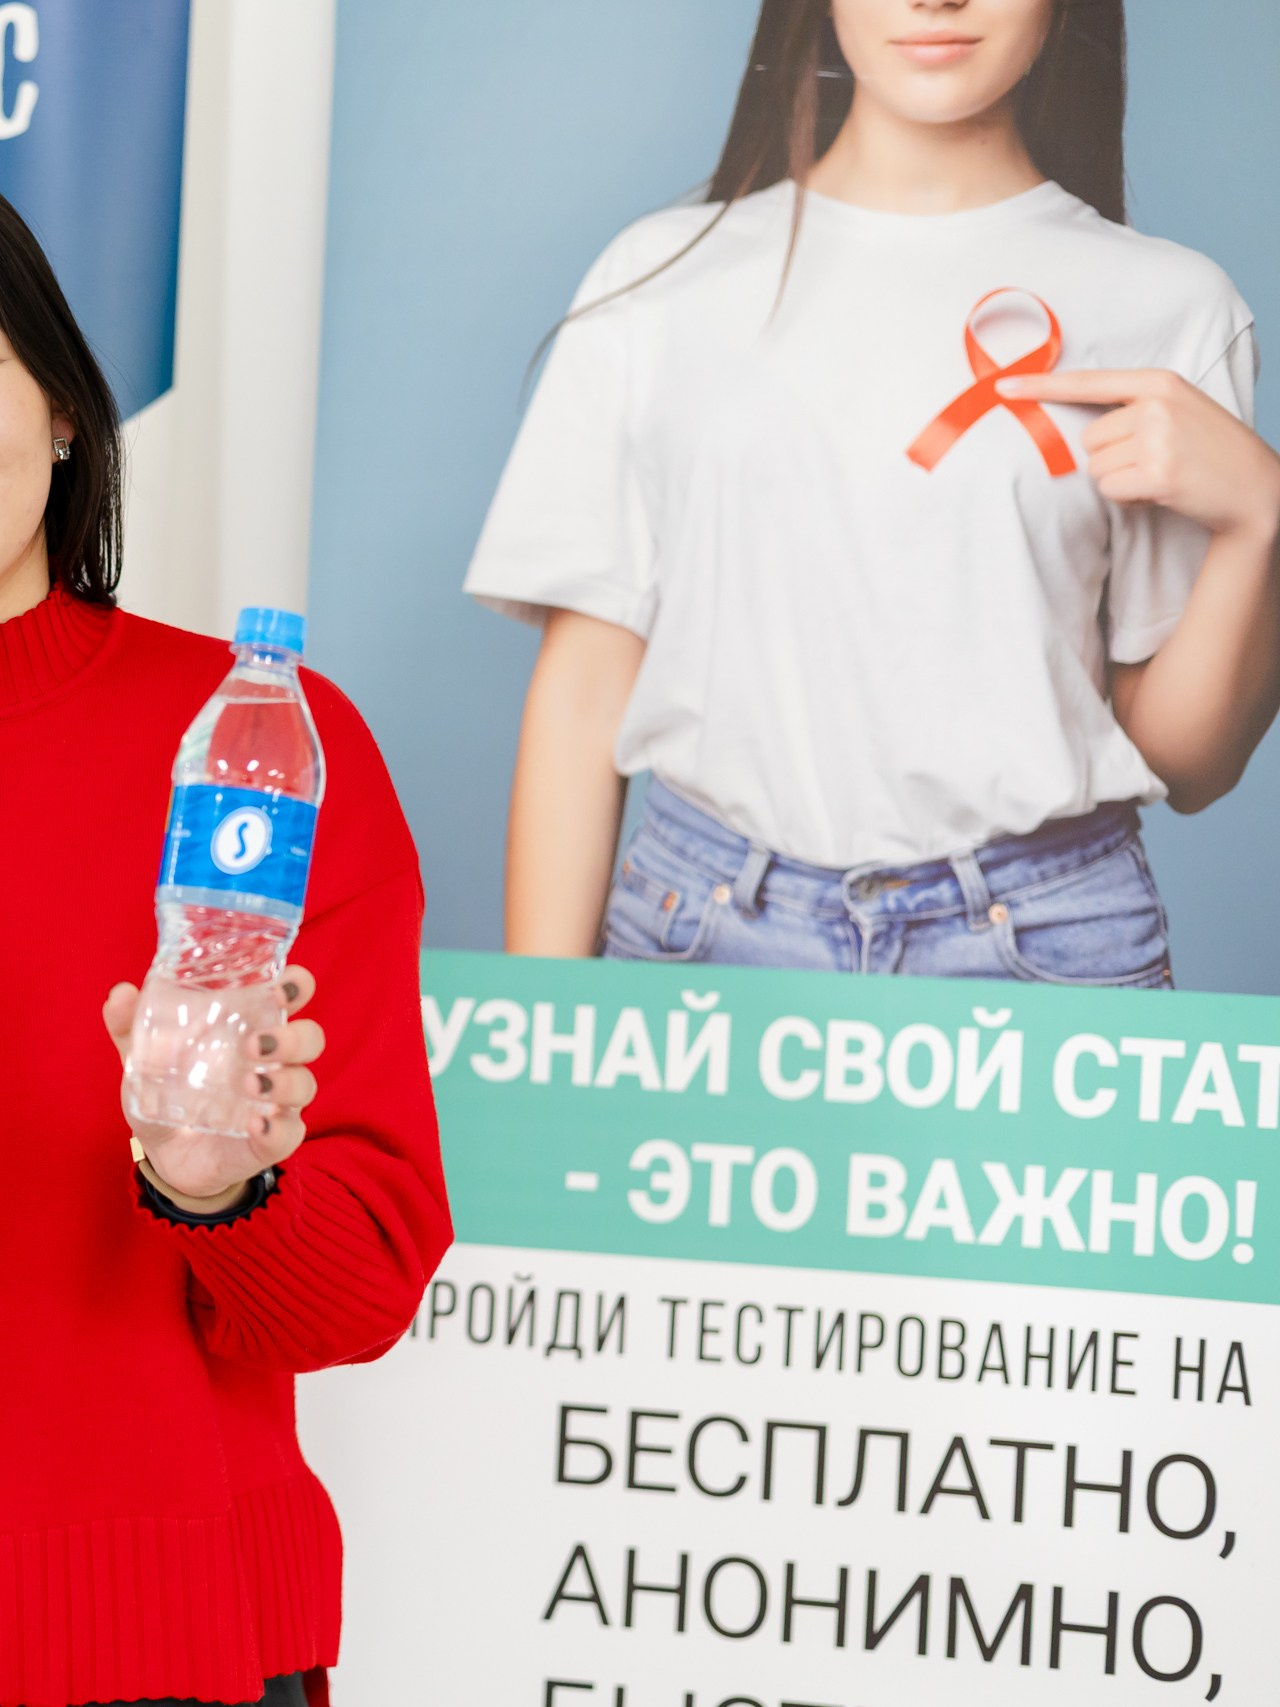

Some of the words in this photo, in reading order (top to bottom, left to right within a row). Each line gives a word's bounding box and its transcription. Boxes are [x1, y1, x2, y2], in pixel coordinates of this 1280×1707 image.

[421, 989, 732, 1097] УЗНАЙ
[758, 1006, 1024, 1114] СВОЙ
[1052, 1033, 1280, 1130] СТАТ
[626, 1138, 819, 1233] ЭТО
[846, 1151, 1258, 1266] ВАЖНО!
[410, 1271, 629, 1361] РОЙДИ
[658, 1296, 1141, 1397] ТЕСТИРОВАНИЕ
[1172, 1336, 1255, 1407] НА
[554, 1403, 1240, 1560] БЕСПЛАТНО,
[543, 1541, 1223, 1703] АНОНИМНО,
